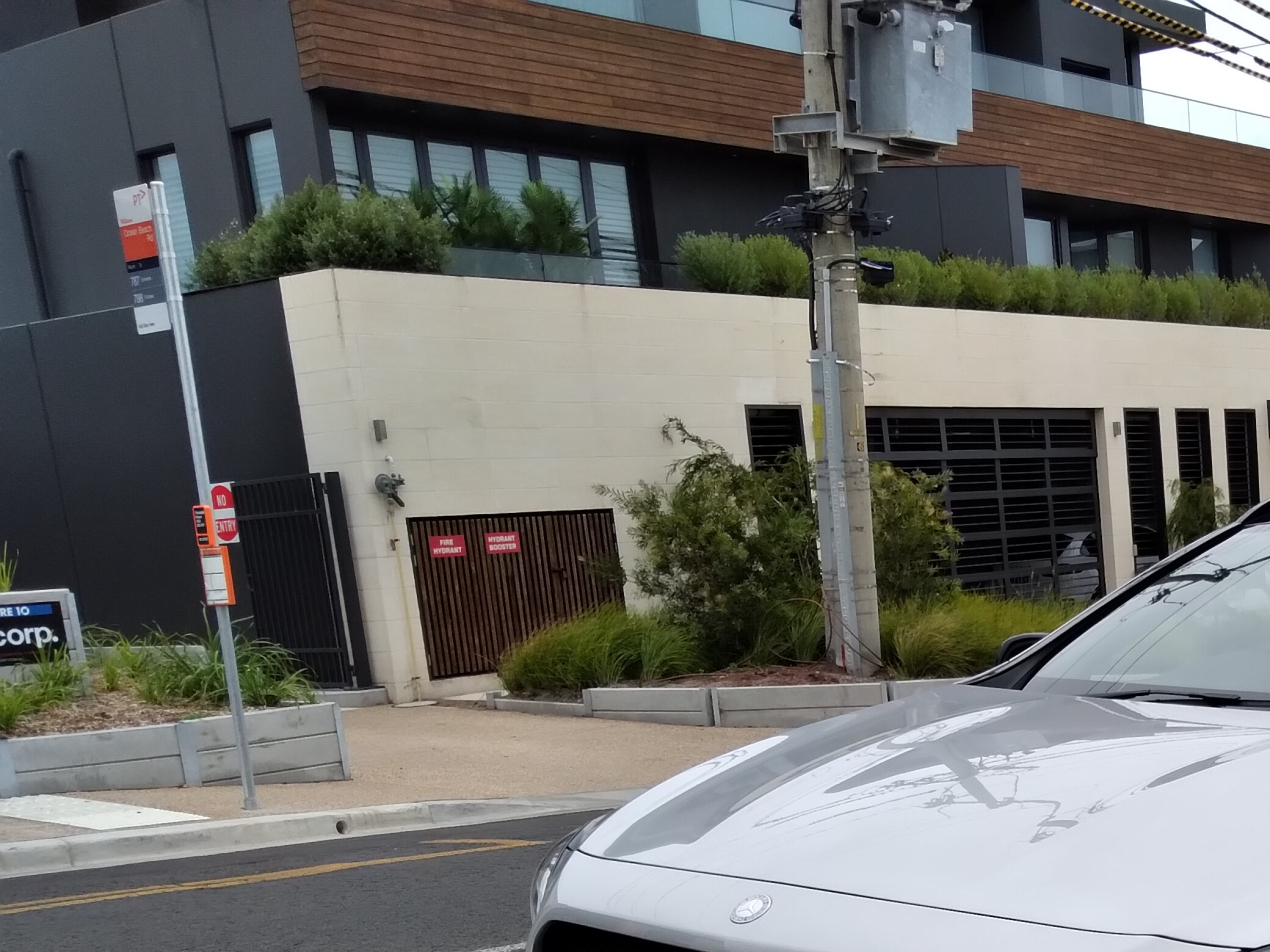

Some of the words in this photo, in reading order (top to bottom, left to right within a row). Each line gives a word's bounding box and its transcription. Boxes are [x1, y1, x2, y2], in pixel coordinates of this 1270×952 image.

[216, 494, 227, 507] NO
[216, 519, 237, 533] ENTRY
[440, 538, 454, 546] FIRE
[488, 535, 515, 543] HYDRANT
[433, 546, 462, 555] HYDRANT
[489, 543, 517, 551] BOOSTER
